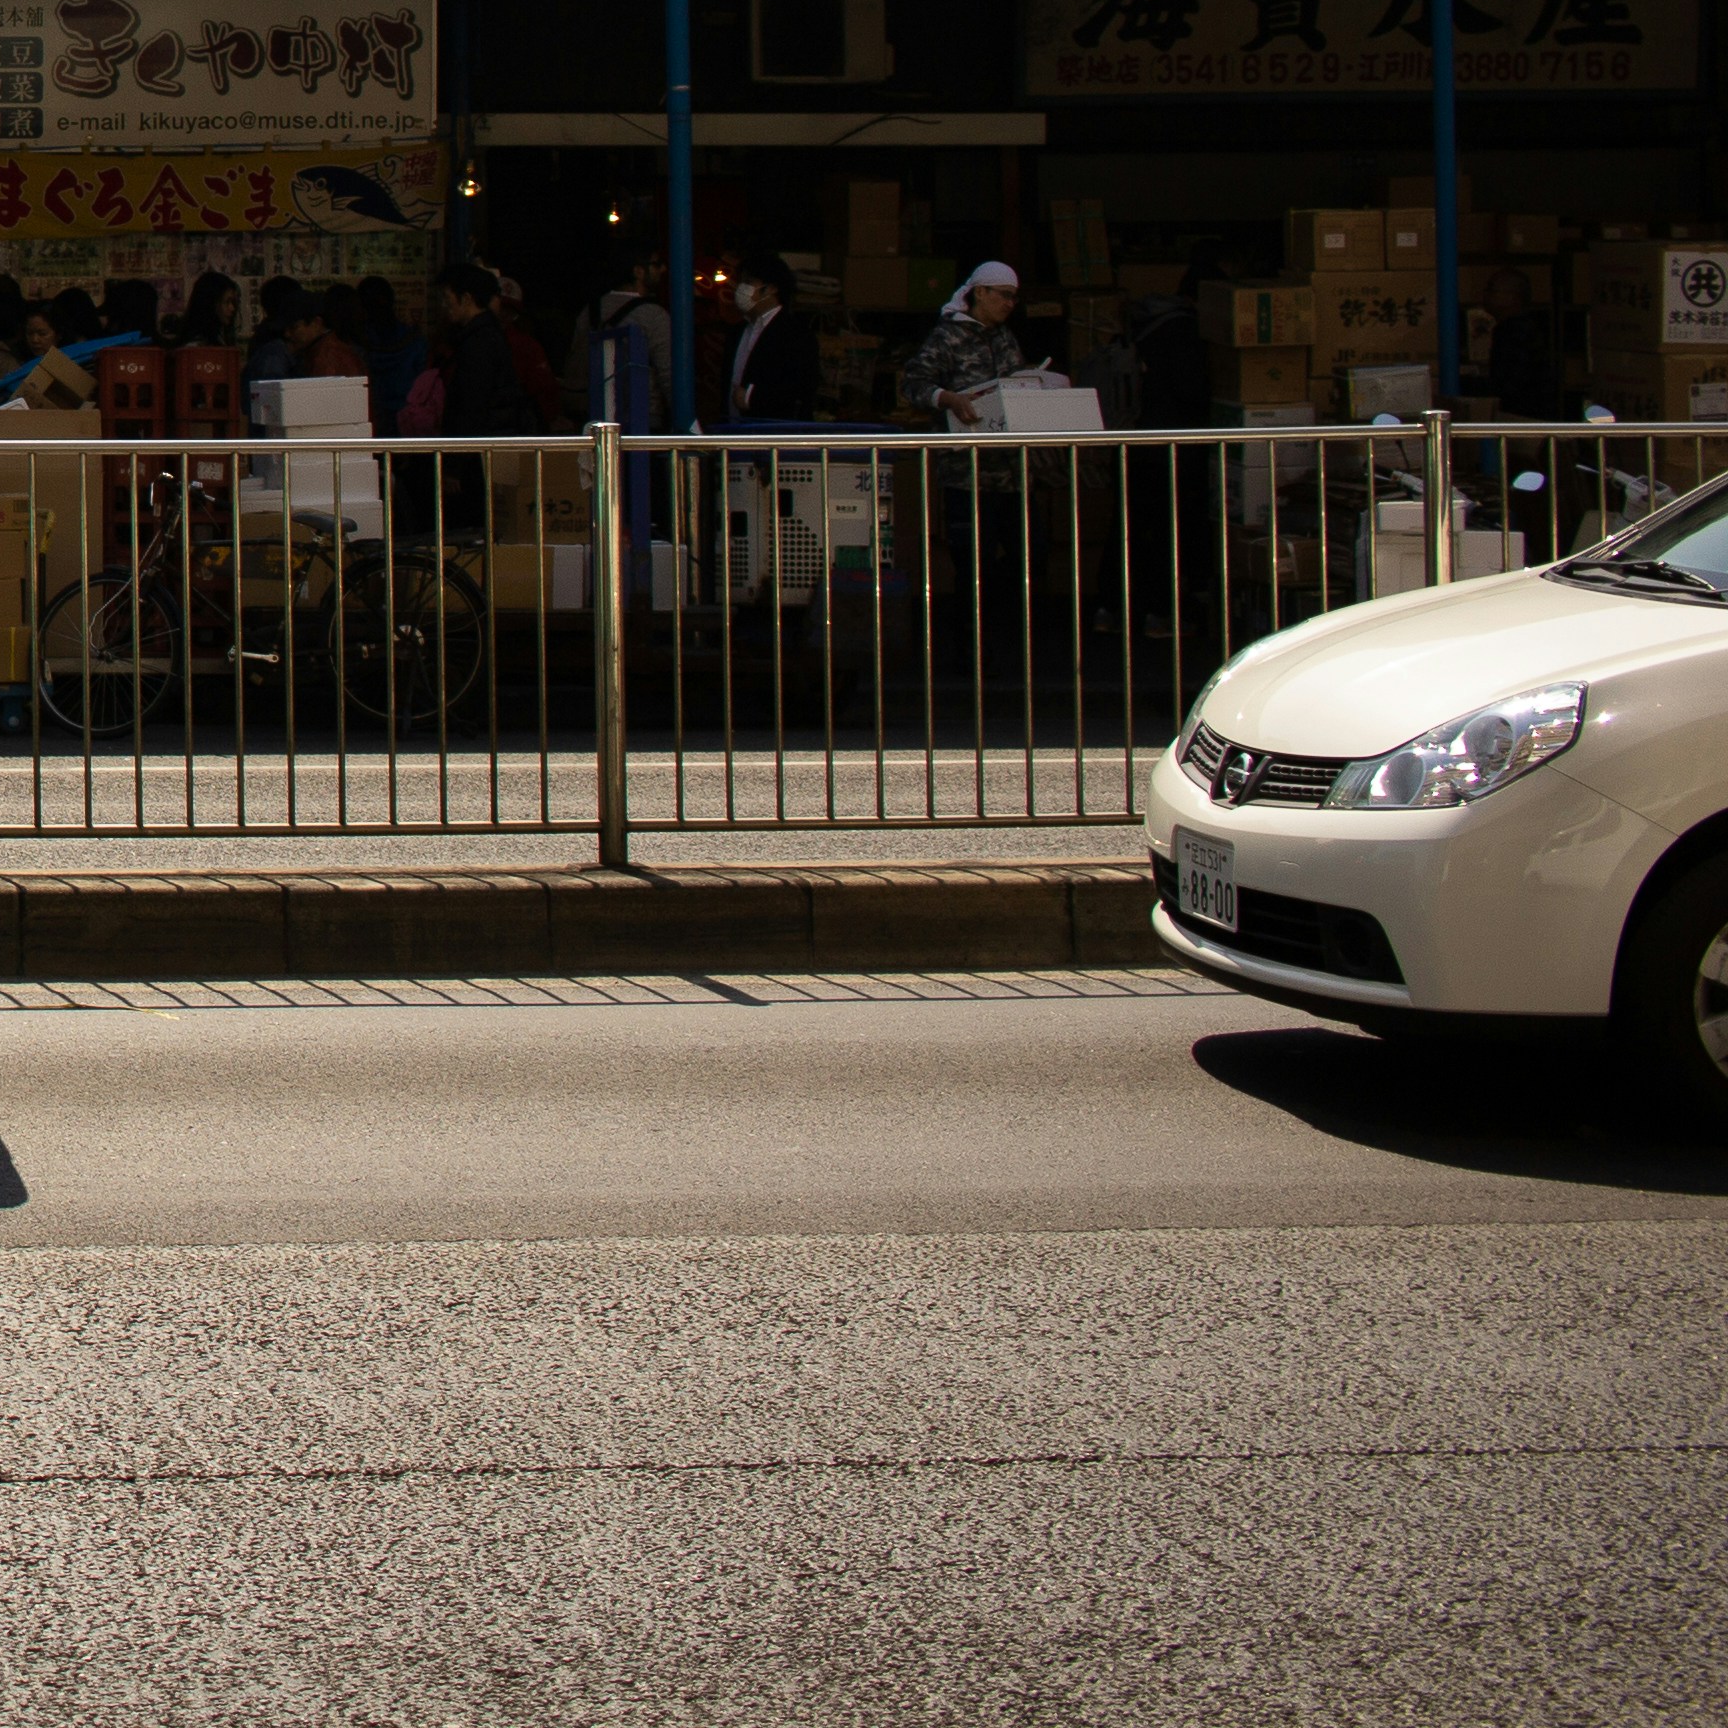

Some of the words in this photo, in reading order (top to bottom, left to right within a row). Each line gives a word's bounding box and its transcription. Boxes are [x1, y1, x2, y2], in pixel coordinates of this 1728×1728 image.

[1055, 53, 1140, 87] 築地店
[56, 112, 126, 132] e-mail
[139, 110, 415, 135] kikuyaco@muse.dti.ne.jp
[1190, 869, 1235, 924] 88-00
